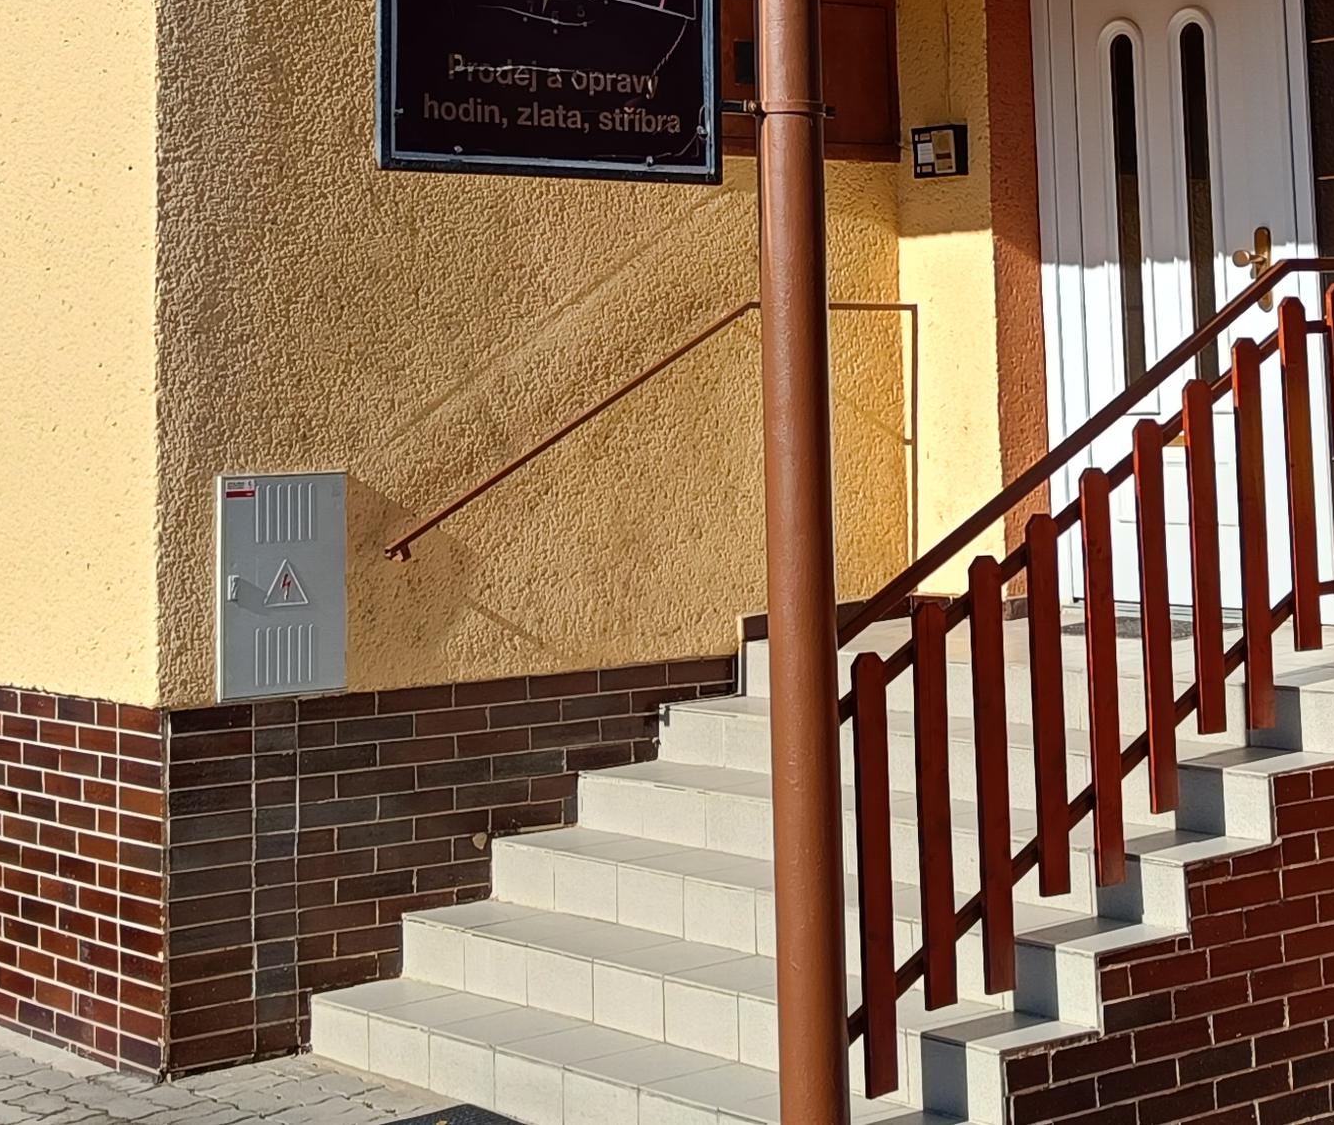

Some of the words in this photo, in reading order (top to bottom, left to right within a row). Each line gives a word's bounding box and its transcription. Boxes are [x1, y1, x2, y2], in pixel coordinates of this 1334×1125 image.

[448, 54, 537, 92] Prodej
[547, 68, 563, 88] a
[572, 69, 659, 99] opravy
[423, 93, 508, 128] hodin,
[517, 102, 589, 133] zlata,
[599, 106, 681, 133] stříbra
